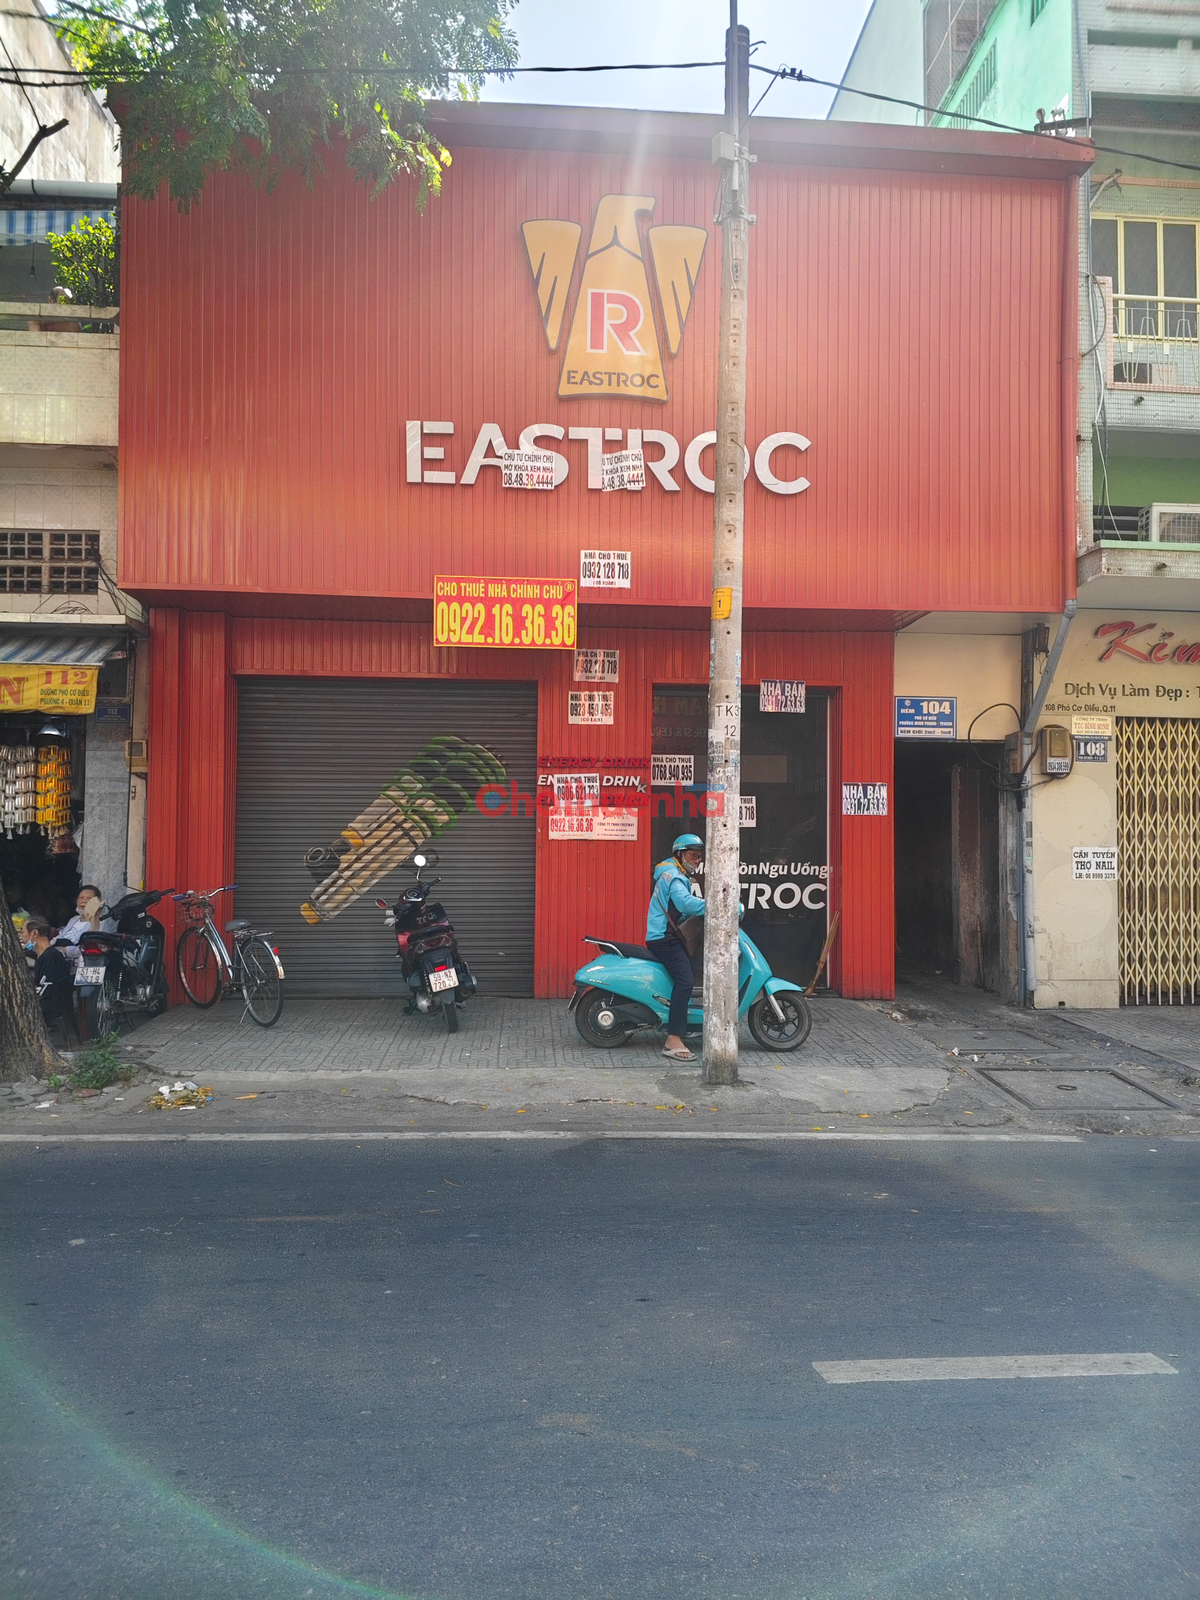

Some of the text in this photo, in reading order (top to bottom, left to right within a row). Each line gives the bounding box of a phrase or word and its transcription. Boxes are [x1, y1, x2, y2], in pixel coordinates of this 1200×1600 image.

[587, 288, 647, 356] R
[566, 370, 660, 389] EASTROC
[406, 420, 812, 494] EASTROC
[503, 472, 554, 488] 08.48.38.4444
[598, 552, 611, 560] CHO
[582, 562, 629, 580] 0932 128 718
[437, 582, 458, 596] CHO
[460, 580, 485, 597] THUÊ
[488, 580, 508, 598] NHÀ
[510, 581, 540, 599] CHÍNH
[543, 581, 563, 599] CHỦ
[717, 599, 722, 608] 1
[437, 601, 575, 645] 0922.16.36.36
[607, 660, 618, 674] 718
[44, 671, 88, 685] 112
[761, 680, 805, 697] NHÀ BÁN
[1064, 682, 1095, 698] Dịch
[1098, 684, 1117, 700] Vụ
[1122, 683, 1150, 697] Làm
[69, 698, 82, 707] QUẬN
[920, 700, 951, 715] 104
[1072, 704, 1083, 712] Cơ
[724, 725, 736, 737] 12
[1079, 742, 1105, 756] 108
[665, 756, 677, 764] CHO
[843, 782, 864, 799] NHÀ
[867, 782, 887, 799] BÁN
[744, 806, 755, 821] 718
[759, 862, 788, 879] Ngu
[790, 861, 829, 879] Uống
[1075, 860, 1115, 872] THỢ NAIL
